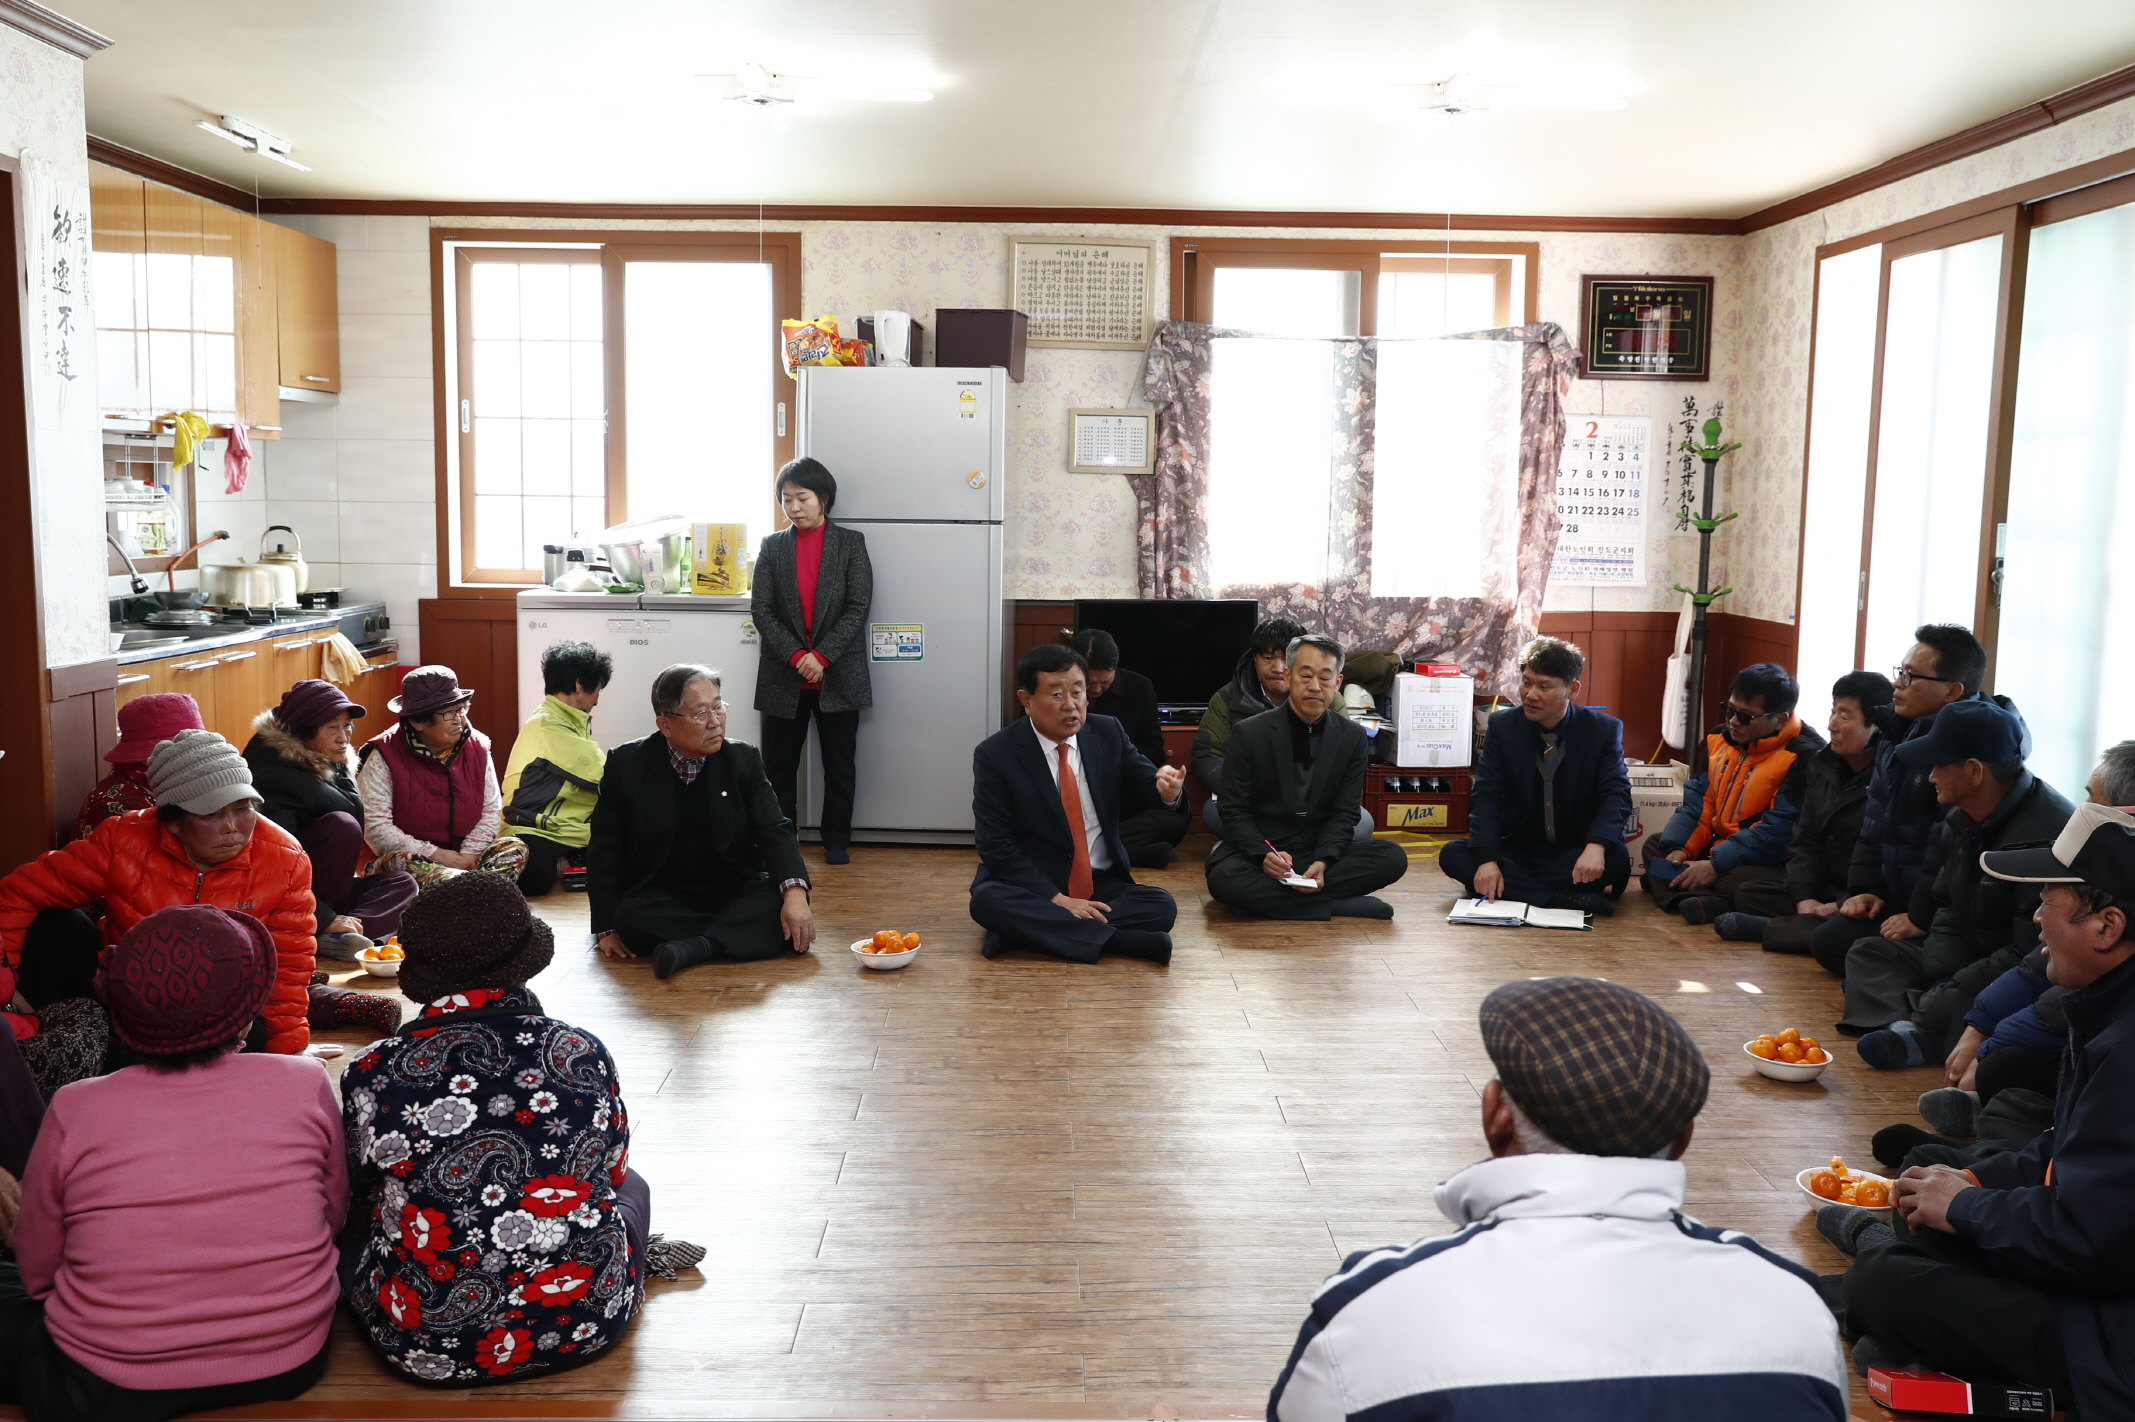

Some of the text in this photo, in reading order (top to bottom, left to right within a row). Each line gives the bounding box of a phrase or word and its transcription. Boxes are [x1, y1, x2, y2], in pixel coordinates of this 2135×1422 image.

[1056, 249, 1109, 259] 어머님의 은혜
[1586, 421, 1598, 438] 2
[1589, 452, 1593, 460] 1
[1603, 452, 1609, 460] 2
[1618, 453, 1624, 461] 3
[1557, 469, 1562, 477] 6
[1587, 470, 1593, 478] 8
[1602, 470, 1608, 478] 9
[1615, 471, 1626, 479] 10
[1631, 471, 1640, 480] 11
[1558, 488, 1640, 498] 3 14 15 16 17 18
[1558, 506, 1639, 516] 0 21 22 23 24 25
[1566, 524, 1578, 532] 28
[1402, 806, 1435, 826] Max
